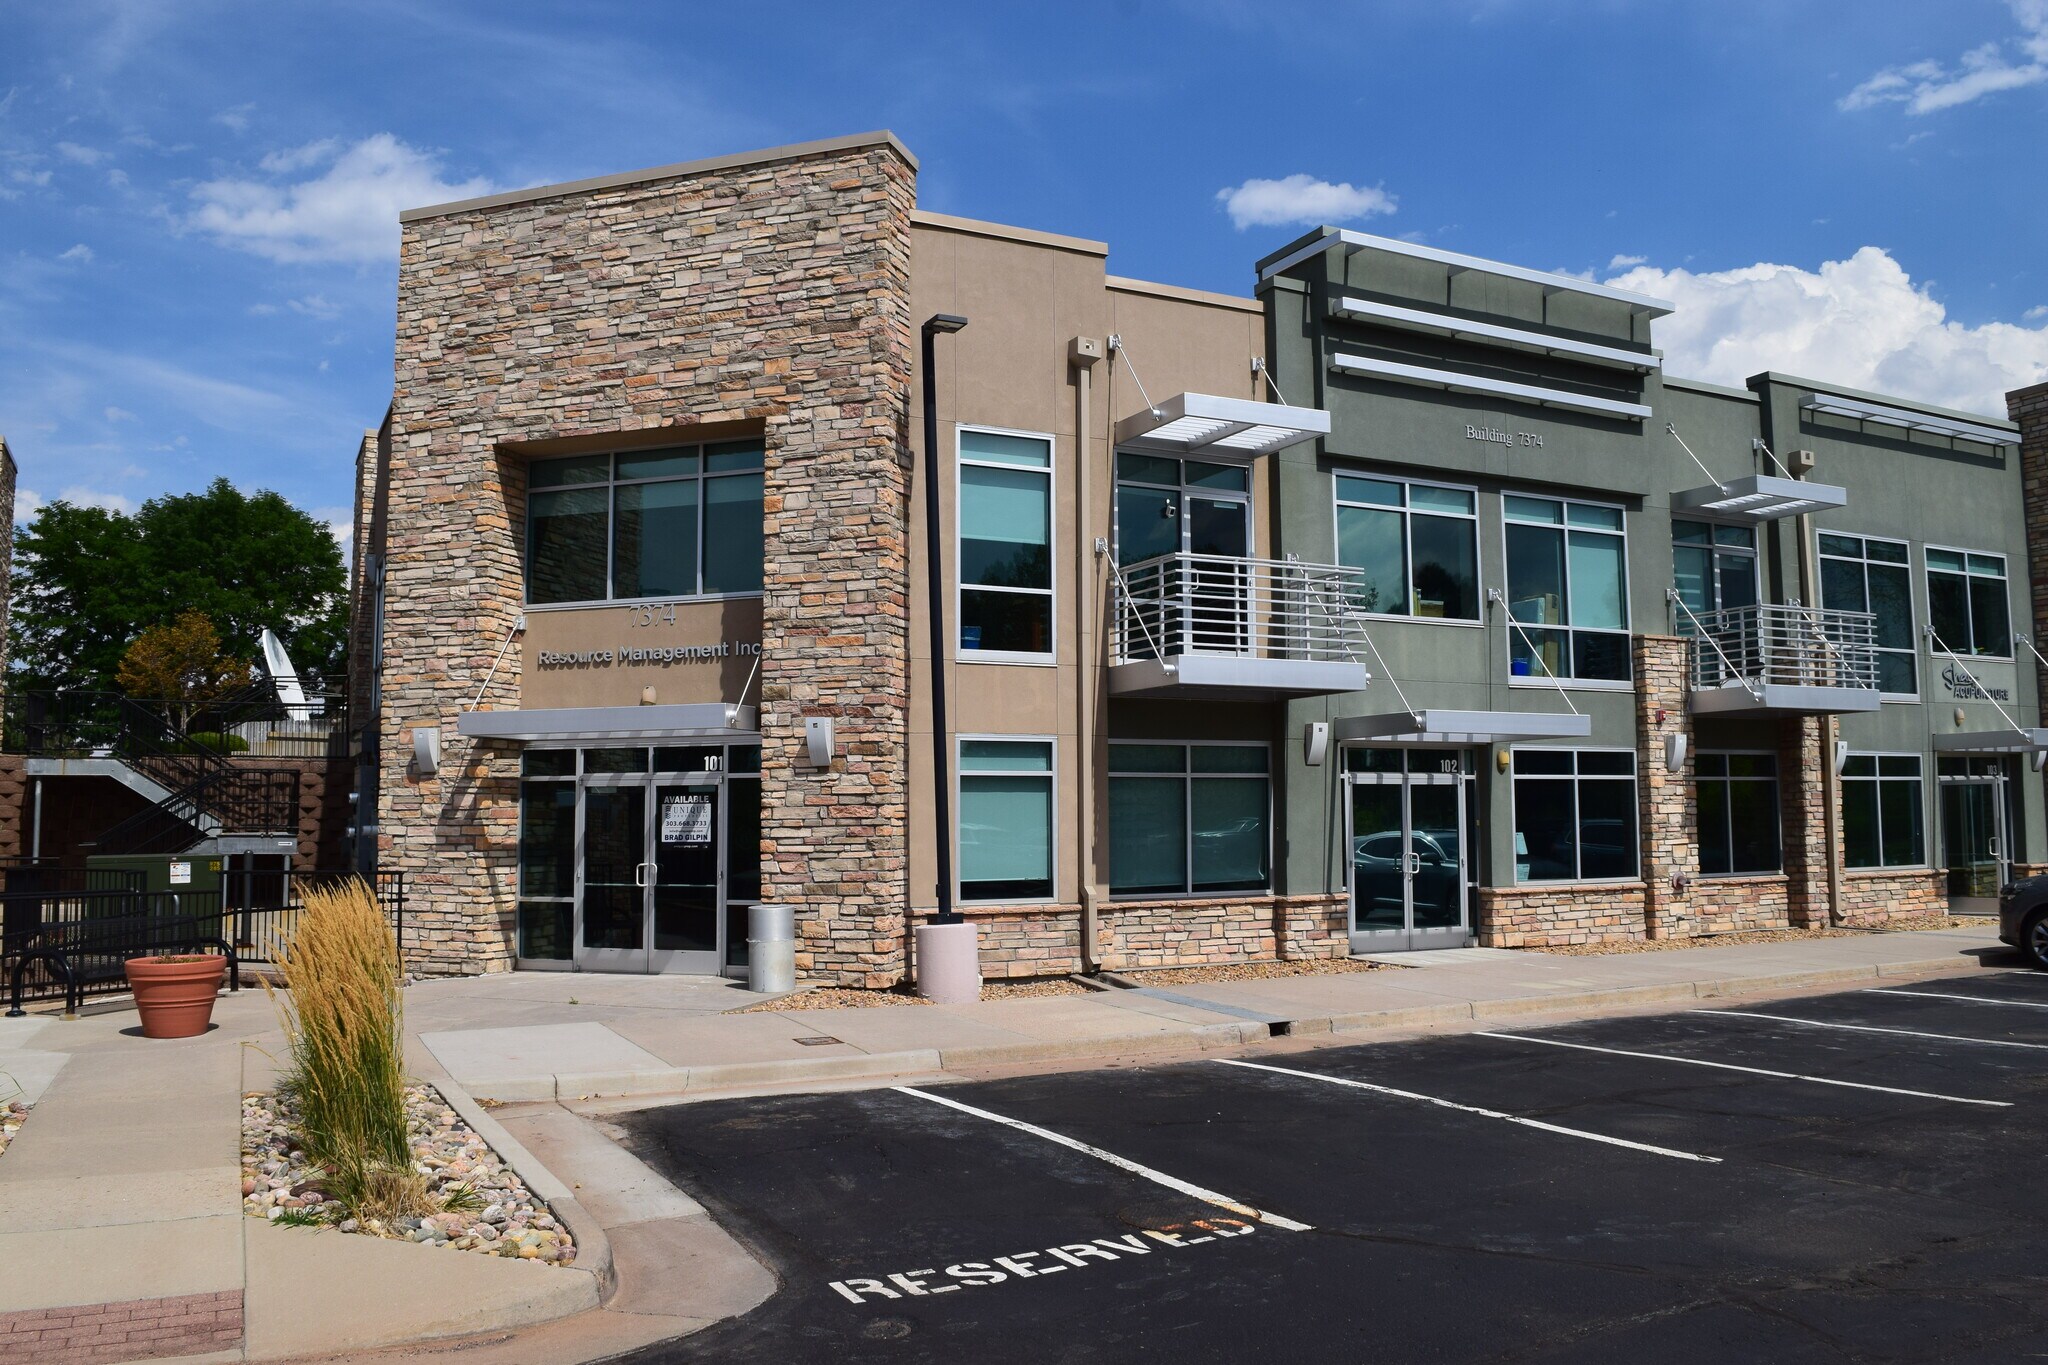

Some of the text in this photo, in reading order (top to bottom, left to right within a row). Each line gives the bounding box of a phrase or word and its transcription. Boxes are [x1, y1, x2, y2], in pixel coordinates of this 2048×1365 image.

[1465, 424, 1544, 448] Building 7374
[629, 603, 676, 628] 7374
[538, 640, 762, 667] Resource Management Inc
[703, 755, 724, 772] 101
[1440, 759, 1458, 773] 102
[1986, 764, 1998, 776] 103
[663, 795, 710, 804] AVAILABLE
[673, 806, 708, 814] UNIQUE
[828, 1216, 1256, 1305] RESERVED
